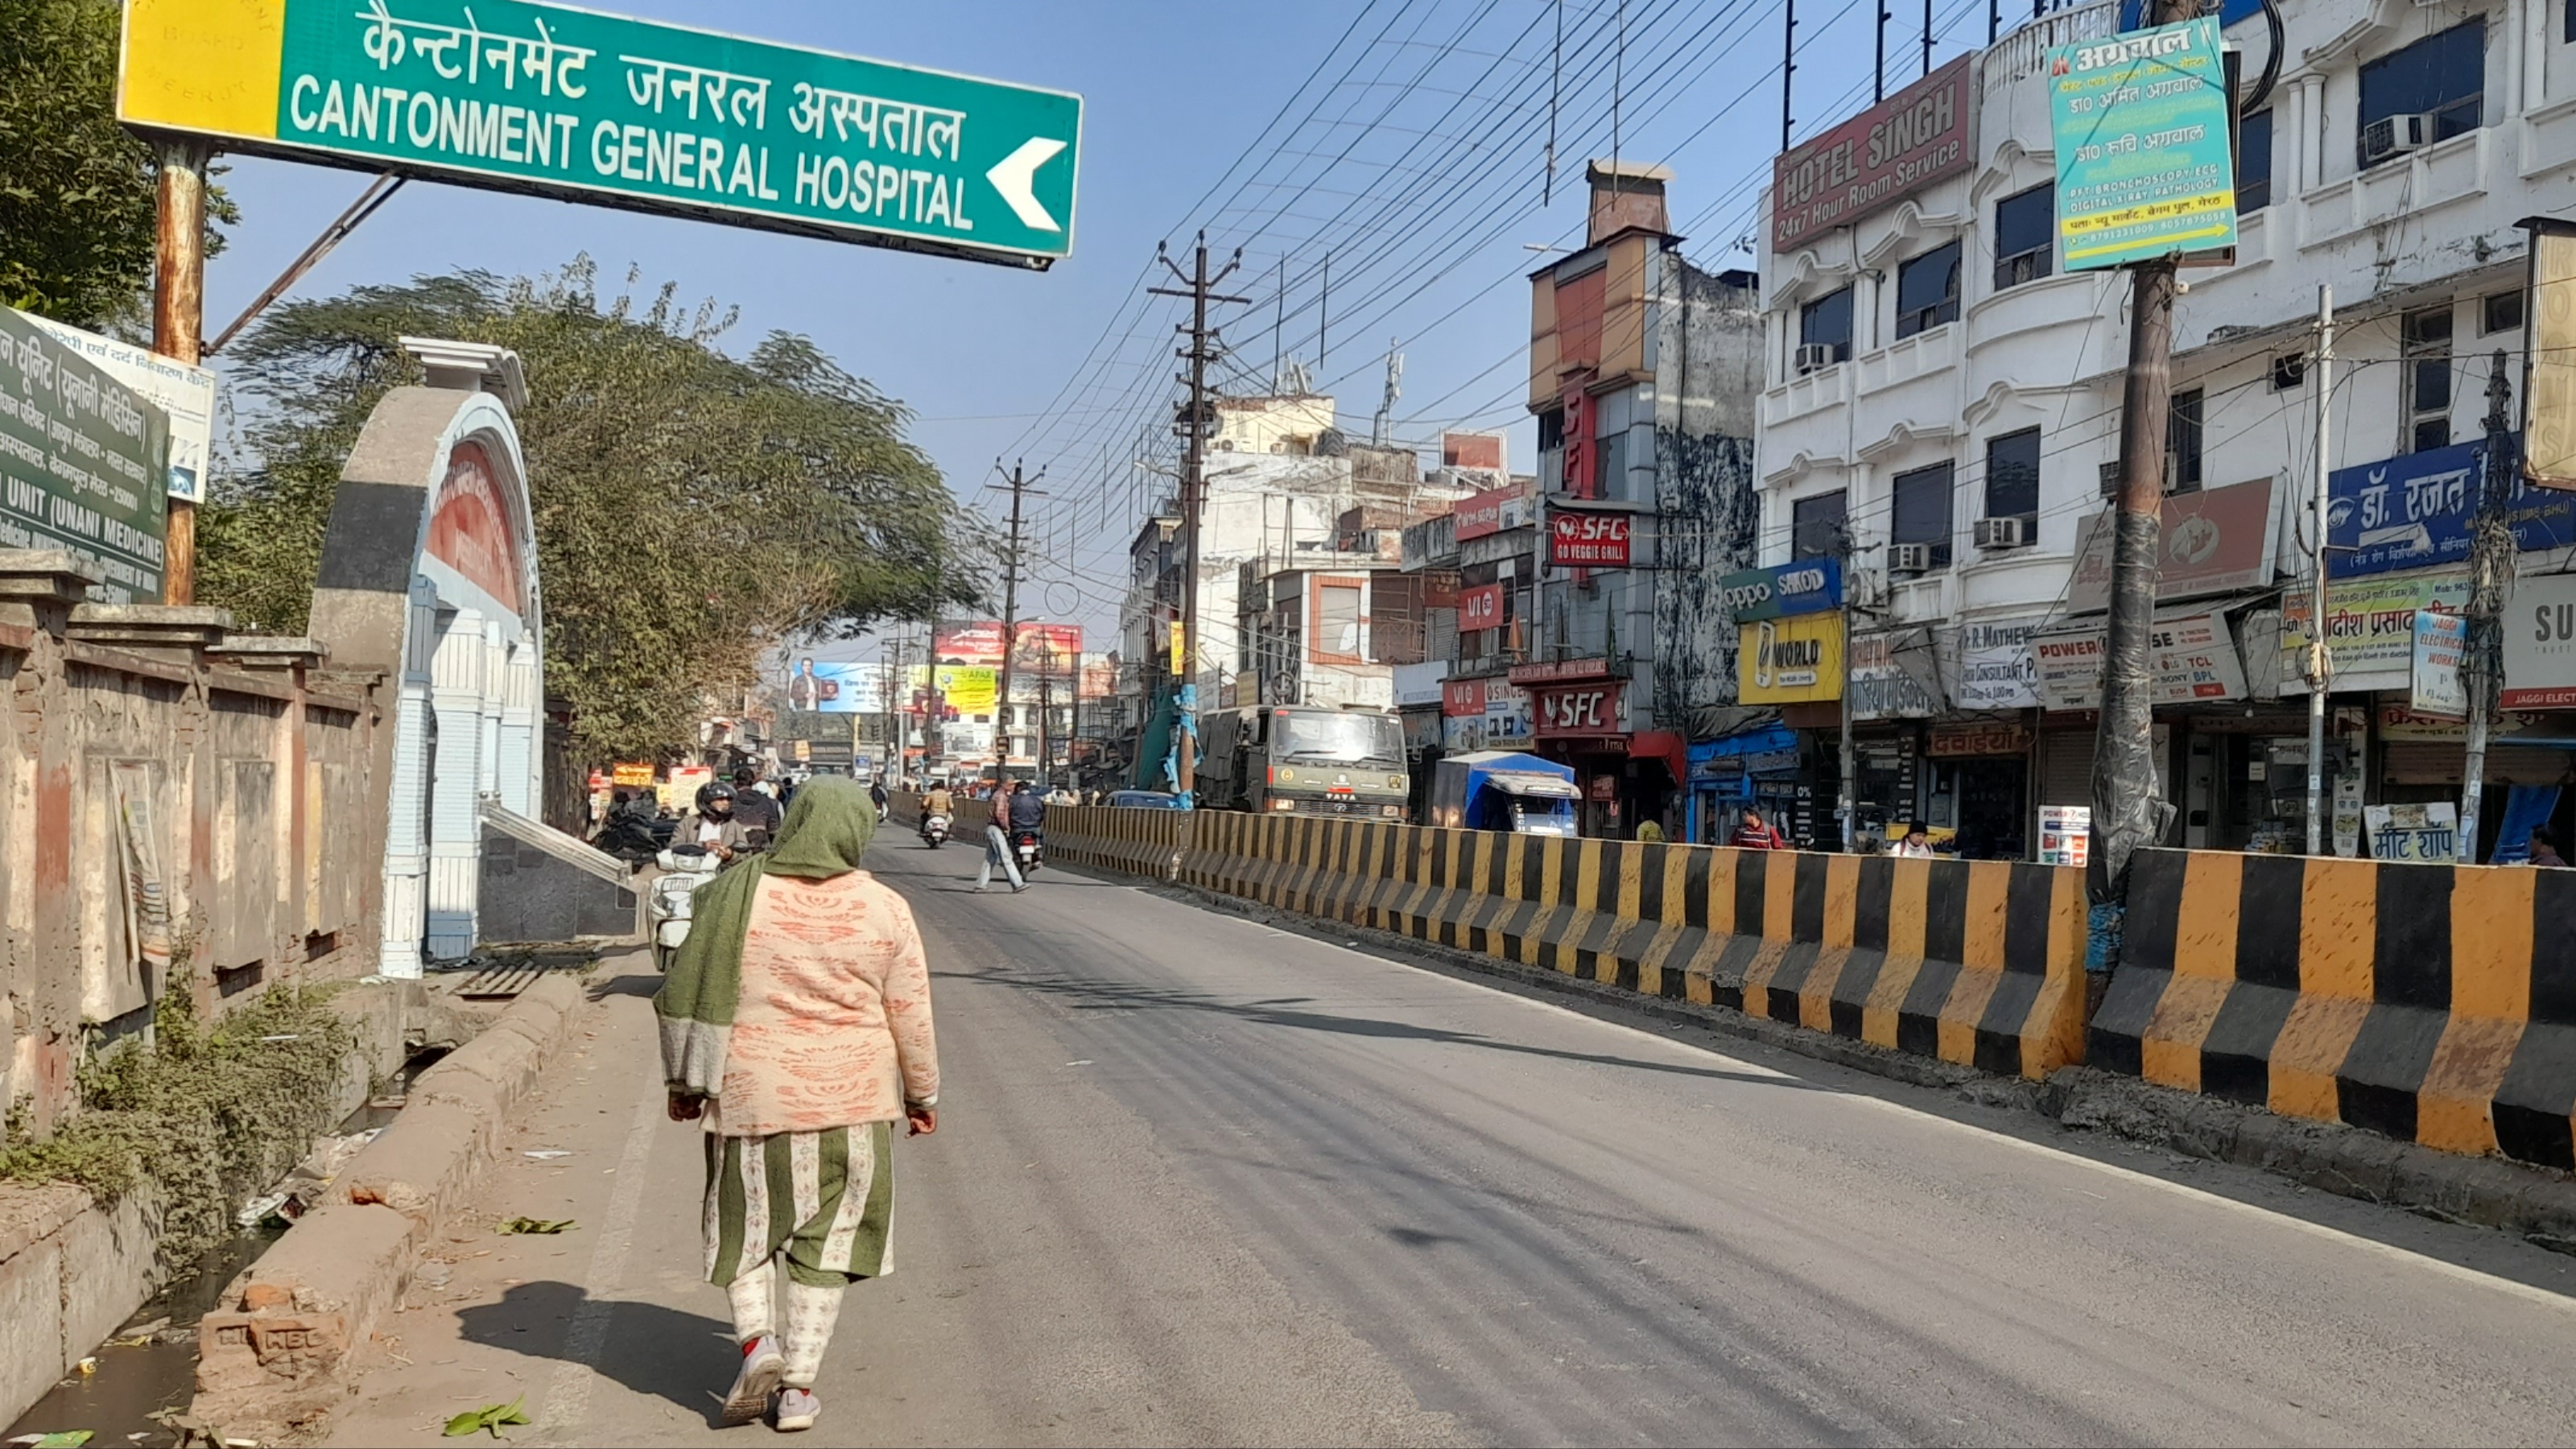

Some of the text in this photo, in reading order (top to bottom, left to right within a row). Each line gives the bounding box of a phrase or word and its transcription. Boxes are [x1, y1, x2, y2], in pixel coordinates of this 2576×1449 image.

[2076, 27, 2193, 72] अग्रवाल
[355, 0, 967, 163] कैन्टोनमेंट जनरल अस्पताल
[2098, 84, 2141, 109] अमित
[2145, 72, 2206, 98] अग्रवाल
[290, 73, 974, 230] CANTONMENT GENERAL HOSPITAL
[1781, 136, 1860, 212] HOTEL
[1866, 81, 1957, 170] SINGH
[2143, 123, 2207, 151] अग्रवाल
[1777, 139, 1960, 242] 24x7 Hour Room Service
[16, 335, 53, 396] यूनिट
[111, 349, 132, 364] दर्द
[135, 354, 185, 382] निवारण
[7, 475, 46, 517] UNIT
[2359, 466, 2390, 530] डॉ.
[2404, 467, 2471, 522] रजत
[1581, 517, 1624, 541] SFC
[1557, 543, 1624, 560] GO VEGGIE GRILL
[2431, 618, 2458, 631] JAGGI
[1774, 640, 1821, 669] WORLD
[2039, 640, 2097, 659] POWER
[2187, 656, 2212, 668] TCL
[2160, 674, 2187, 683] SONY
[2193, 671, 2215, 683] BPL
[1559, 692, 1604, 727] SFC
[2515, 695, 2544, 704] JAGGI
[1326, 793, 1356, 801] TATA
[1798, 786, 1811, 798] 0%
[2374, 820, 2453, 859] मीट शॉप
